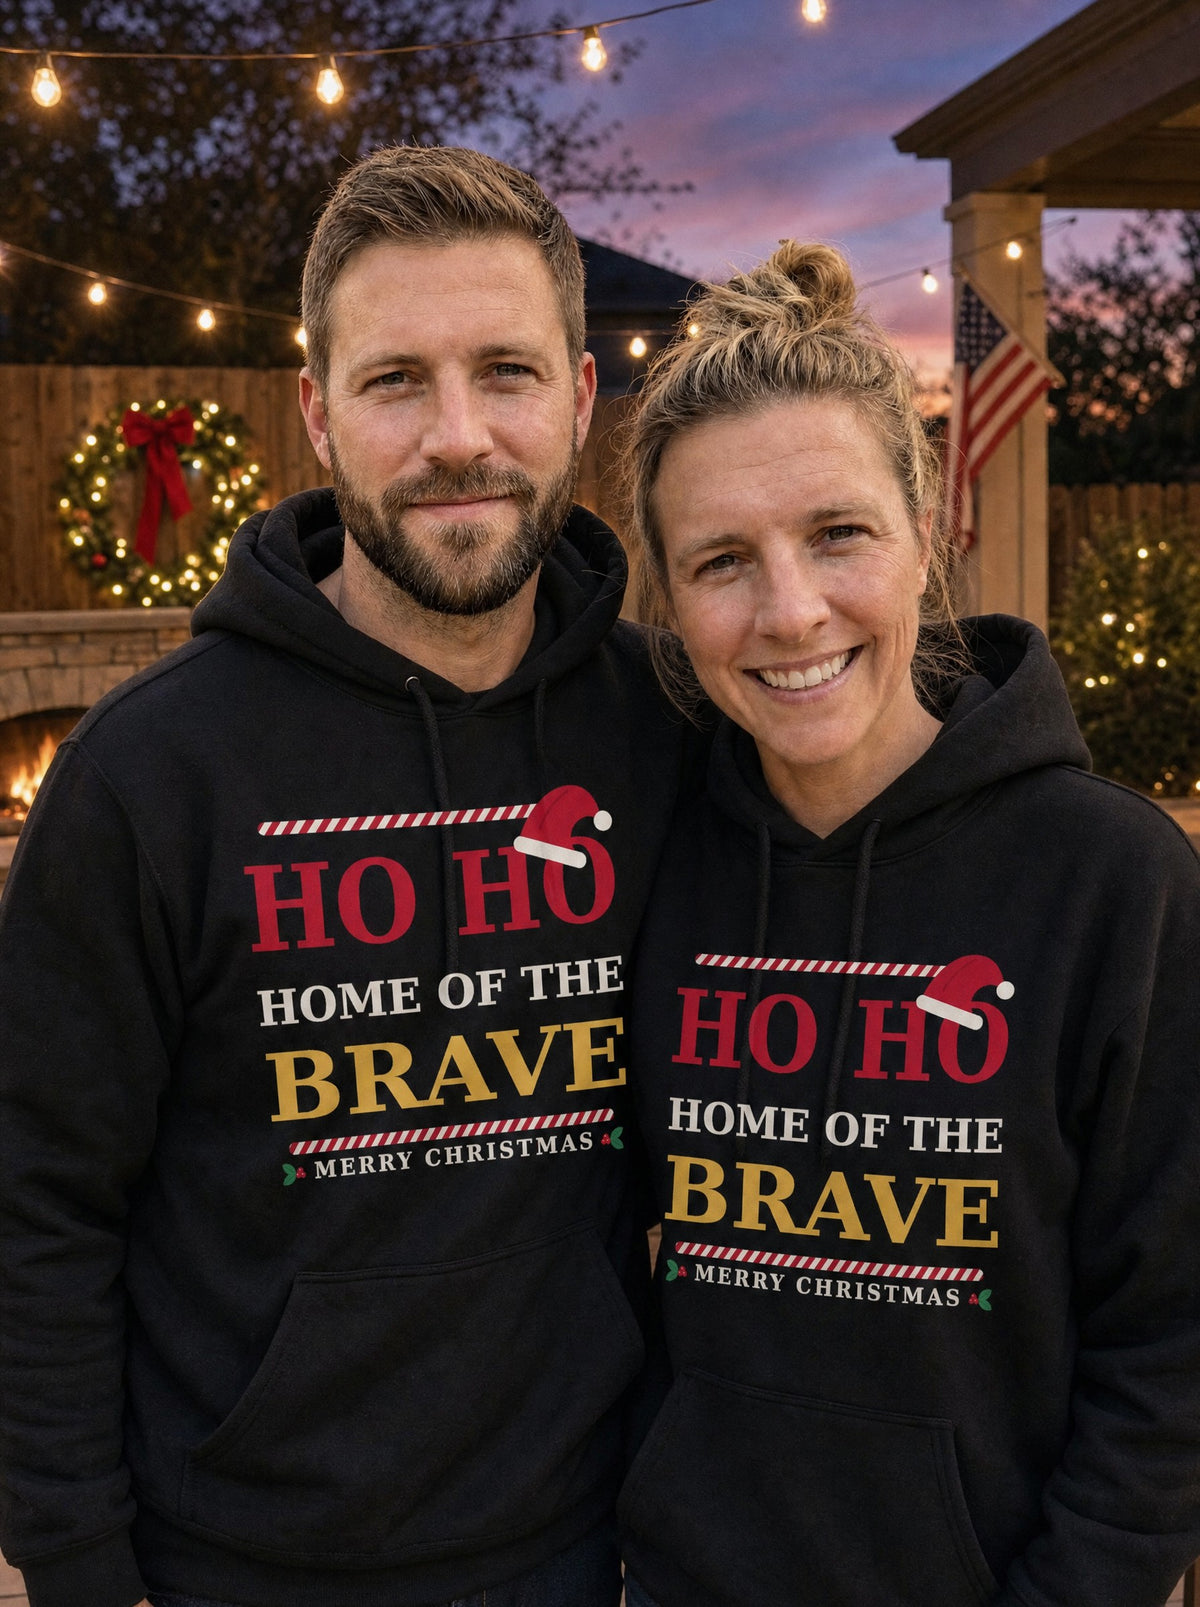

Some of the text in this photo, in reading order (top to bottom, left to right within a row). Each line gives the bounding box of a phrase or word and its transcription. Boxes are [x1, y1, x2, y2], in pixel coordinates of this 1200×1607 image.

[243, 835, 616, 953] HO HO
[257, 955, 624, 1027] HOME OF THE
[265, 1016, 627, 1122] BRAVE
[671, 987, 1009, 1084] HO HO
[314, 1131, 593, 1180] MERRY CHRISTMAS
[668, 1096, 1003, 1154] HOME OF THE
[664, 1154, 999, 1249] BRAVE
[694, 1264, 961, 1307] MERRY CHRISTMAS
